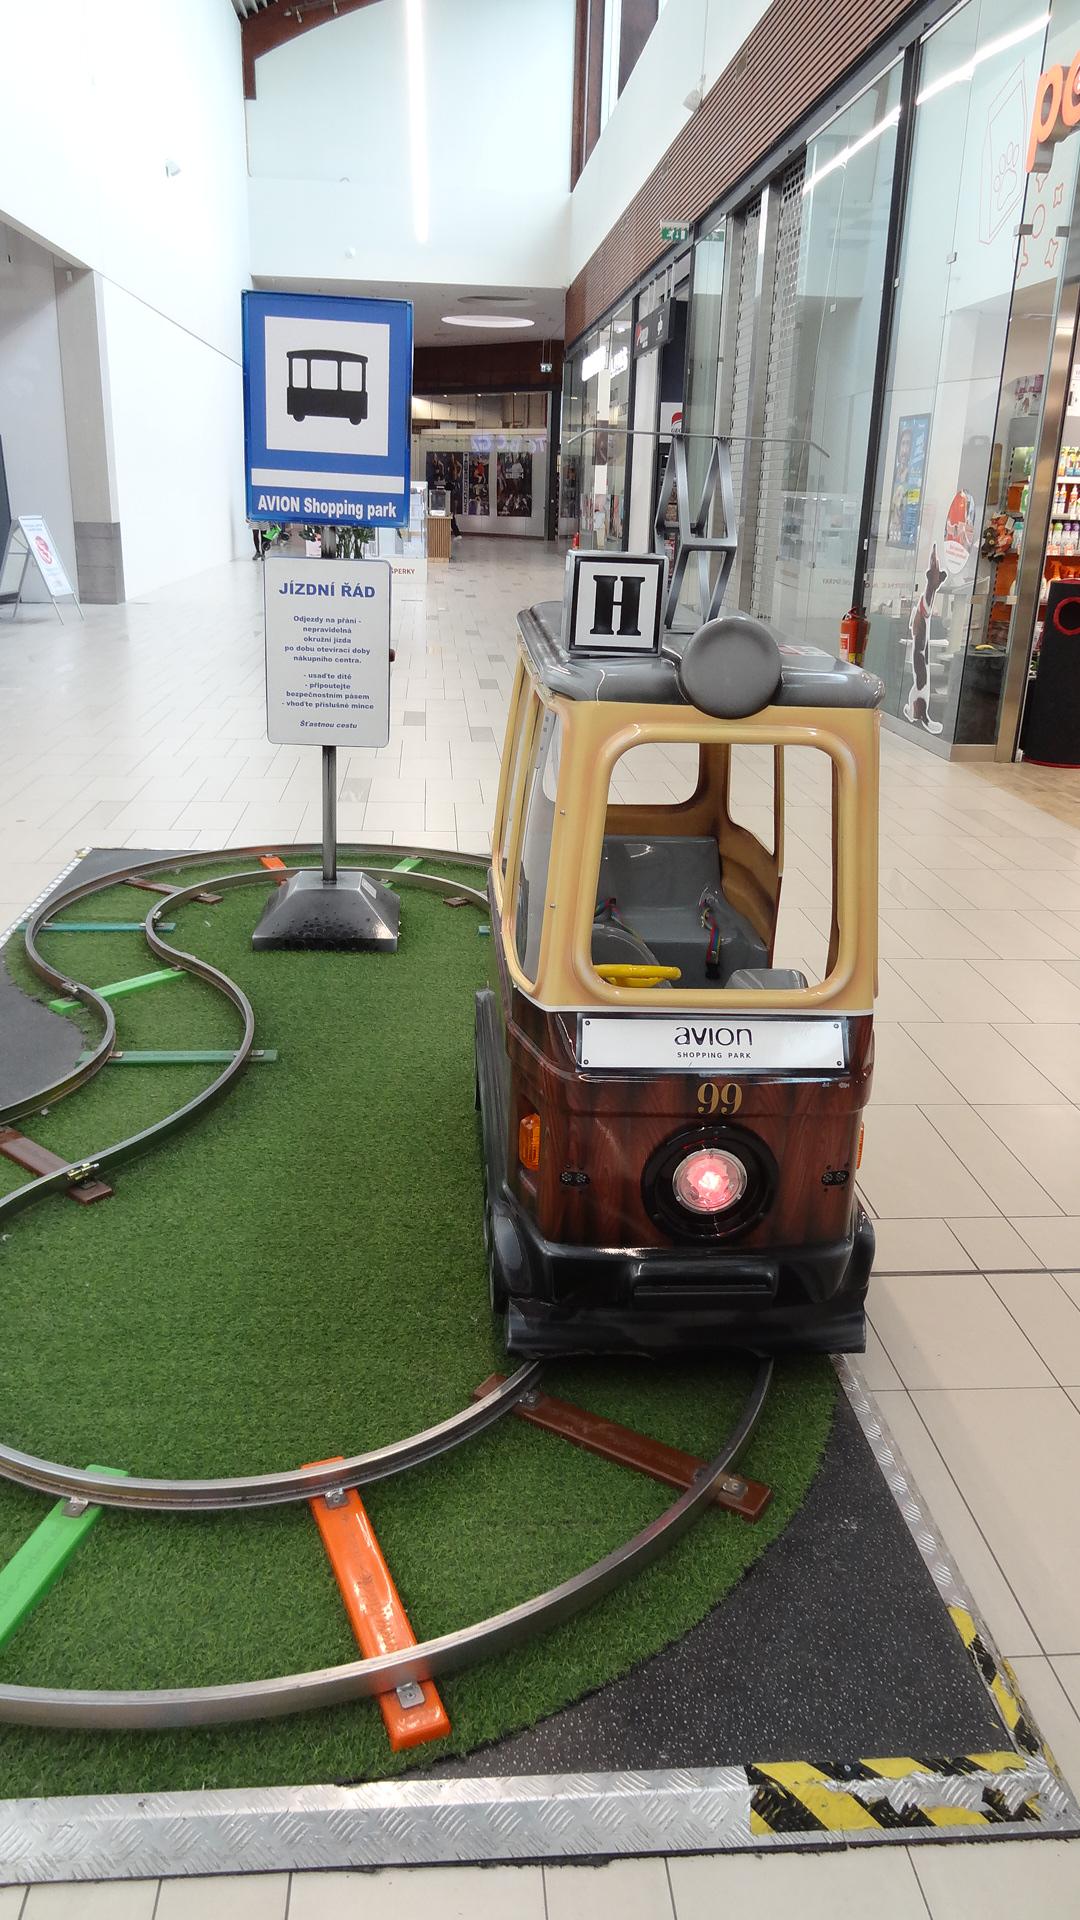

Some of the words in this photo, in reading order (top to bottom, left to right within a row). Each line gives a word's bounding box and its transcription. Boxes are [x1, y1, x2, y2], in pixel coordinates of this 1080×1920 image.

[258, 495, 300, 512] AVION
[304, 498, 363, 519] Shopping
[367, 502, 397, 519] park
[279, 580, 335, 597] JÍZDNÍ
[341, 582, 375, 598] ŘÁD
[590, 574, 645, 636] H
[293, 615, 324, 624] Odjezdy
[352, 647, 371, 655] doby
[336, 721, 358, 729] cestu
[674, 1026, 753, 1046] avion
[677, 1051, 722, 1059] SHOPPING
[697, 1082, 743, 1115] 99
